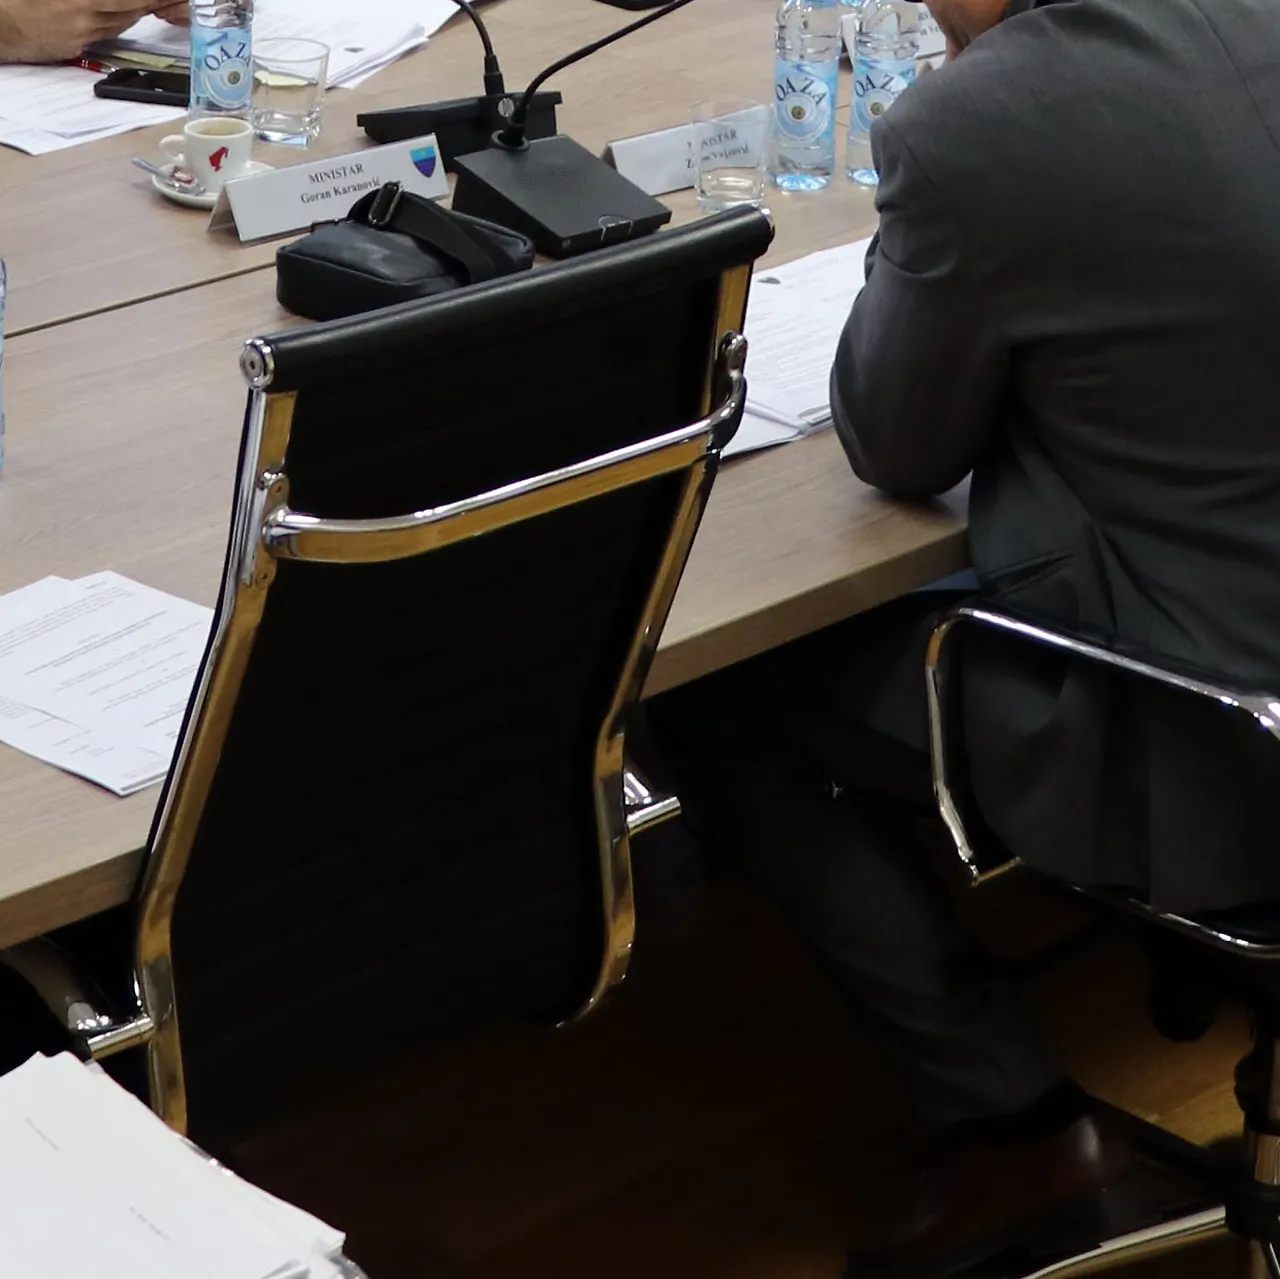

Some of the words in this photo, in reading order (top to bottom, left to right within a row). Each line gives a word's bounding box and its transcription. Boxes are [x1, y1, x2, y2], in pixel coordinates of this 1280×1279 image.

[776, 77, 827, 105] OAZA
[308, 163, 364, 184] MINISTAR
[301, 191, 331, 204] Goran
